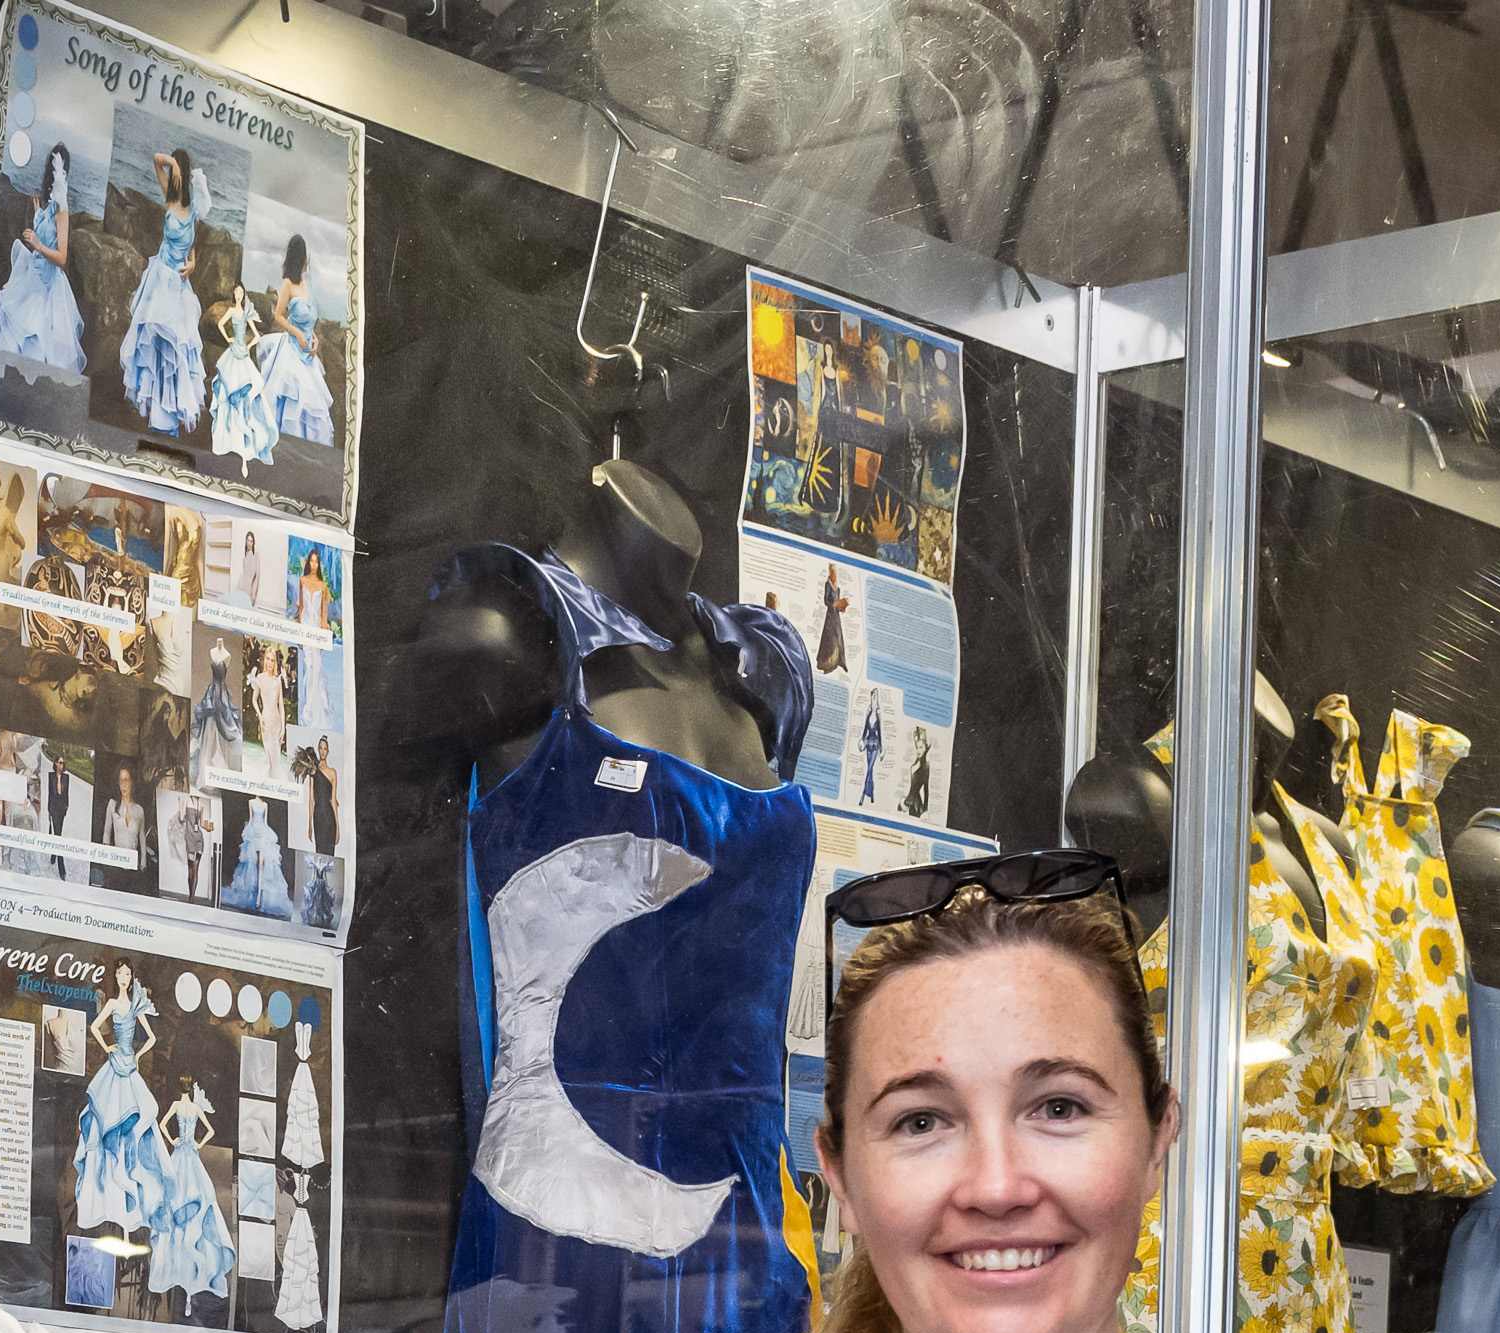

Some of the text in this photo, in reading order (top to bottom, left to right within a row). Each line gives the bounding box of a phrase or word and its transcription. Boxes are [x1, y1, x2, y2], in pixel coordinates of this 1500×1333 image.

[64, 35, 296, 151] Song of the Seirenes
[55, 953, 105, 984] Core
